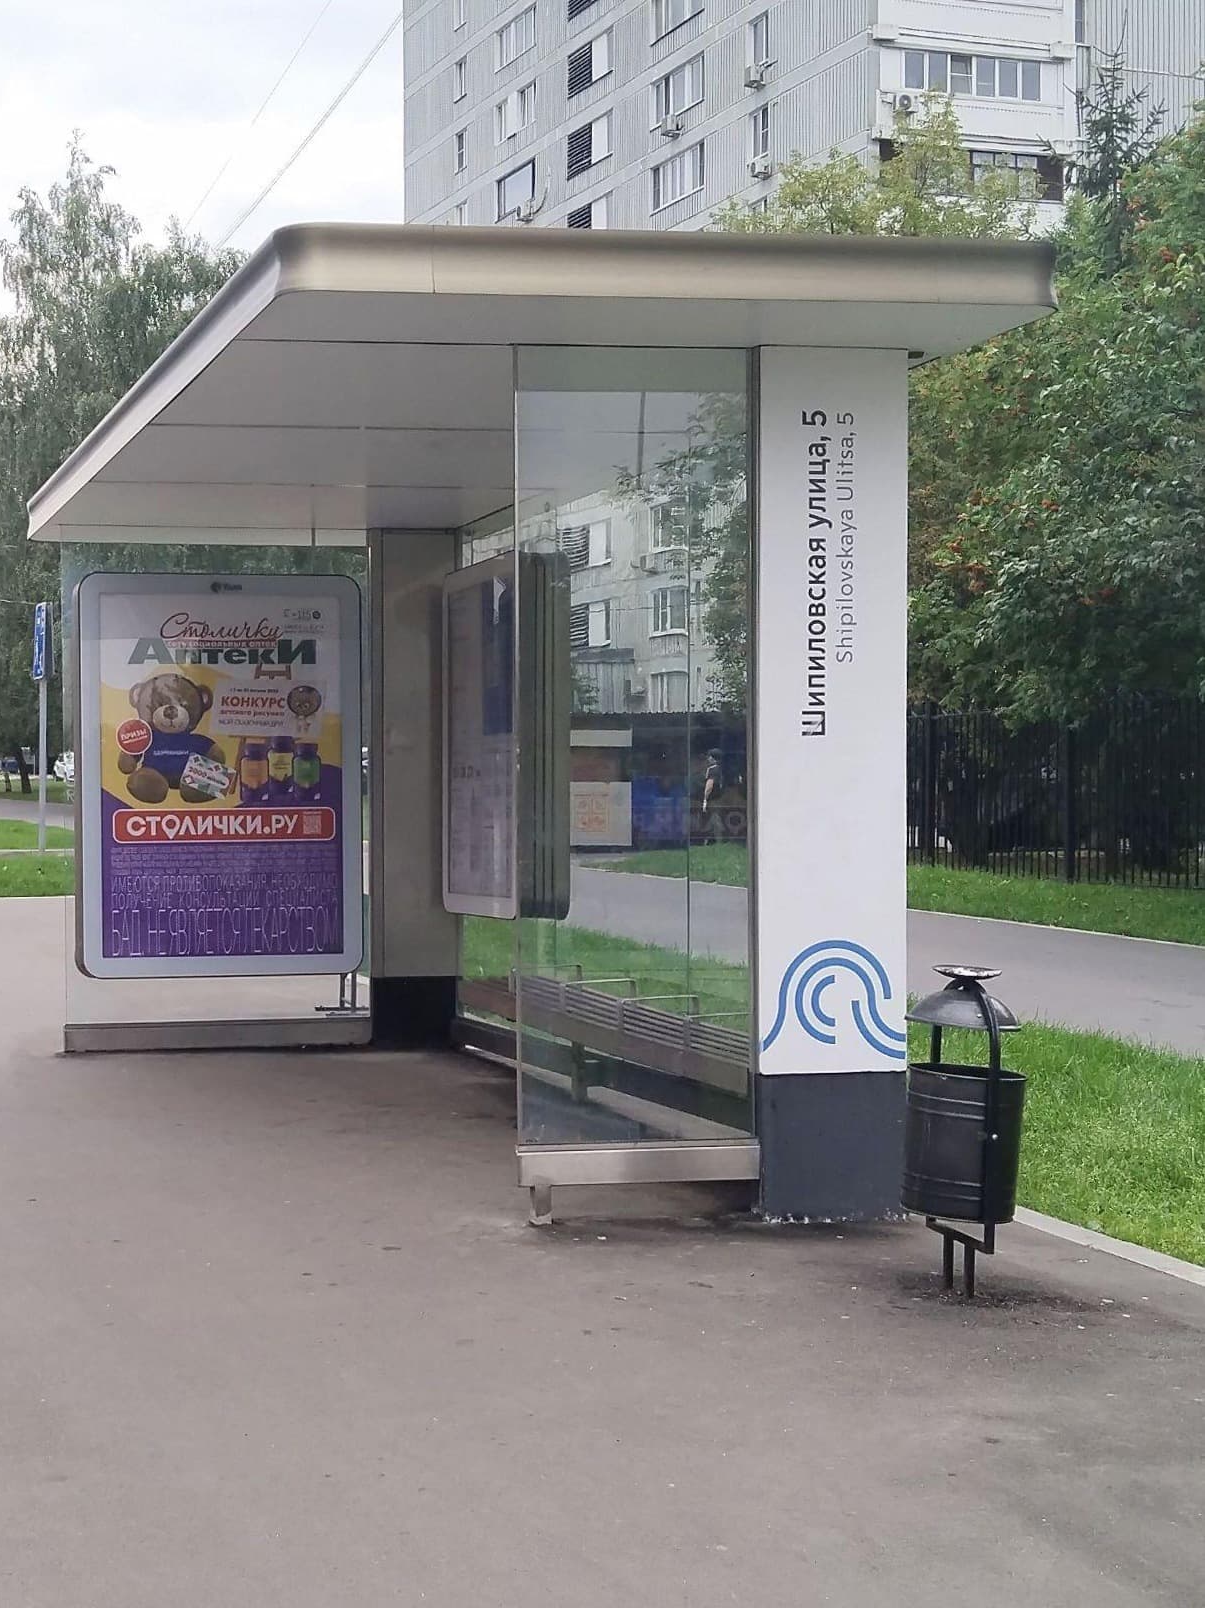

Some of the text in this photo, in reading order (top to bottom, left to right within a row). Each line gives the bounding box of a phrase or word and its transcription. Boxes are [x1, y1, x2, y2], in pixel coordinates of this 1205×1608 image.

[836, 412, 857, 664] Shipilovskaya Ulitsa, 5
[802, 409, 832, 736] Шипиловская улица, 5
[160, 612, 283, 639] Столички
[221, 695, 285, 709] КОНКУРС
[120, 729, 147, 741] ПРИЗЫ
[126, 814, 298, 839] СТОЛИЧКИ.РУ
